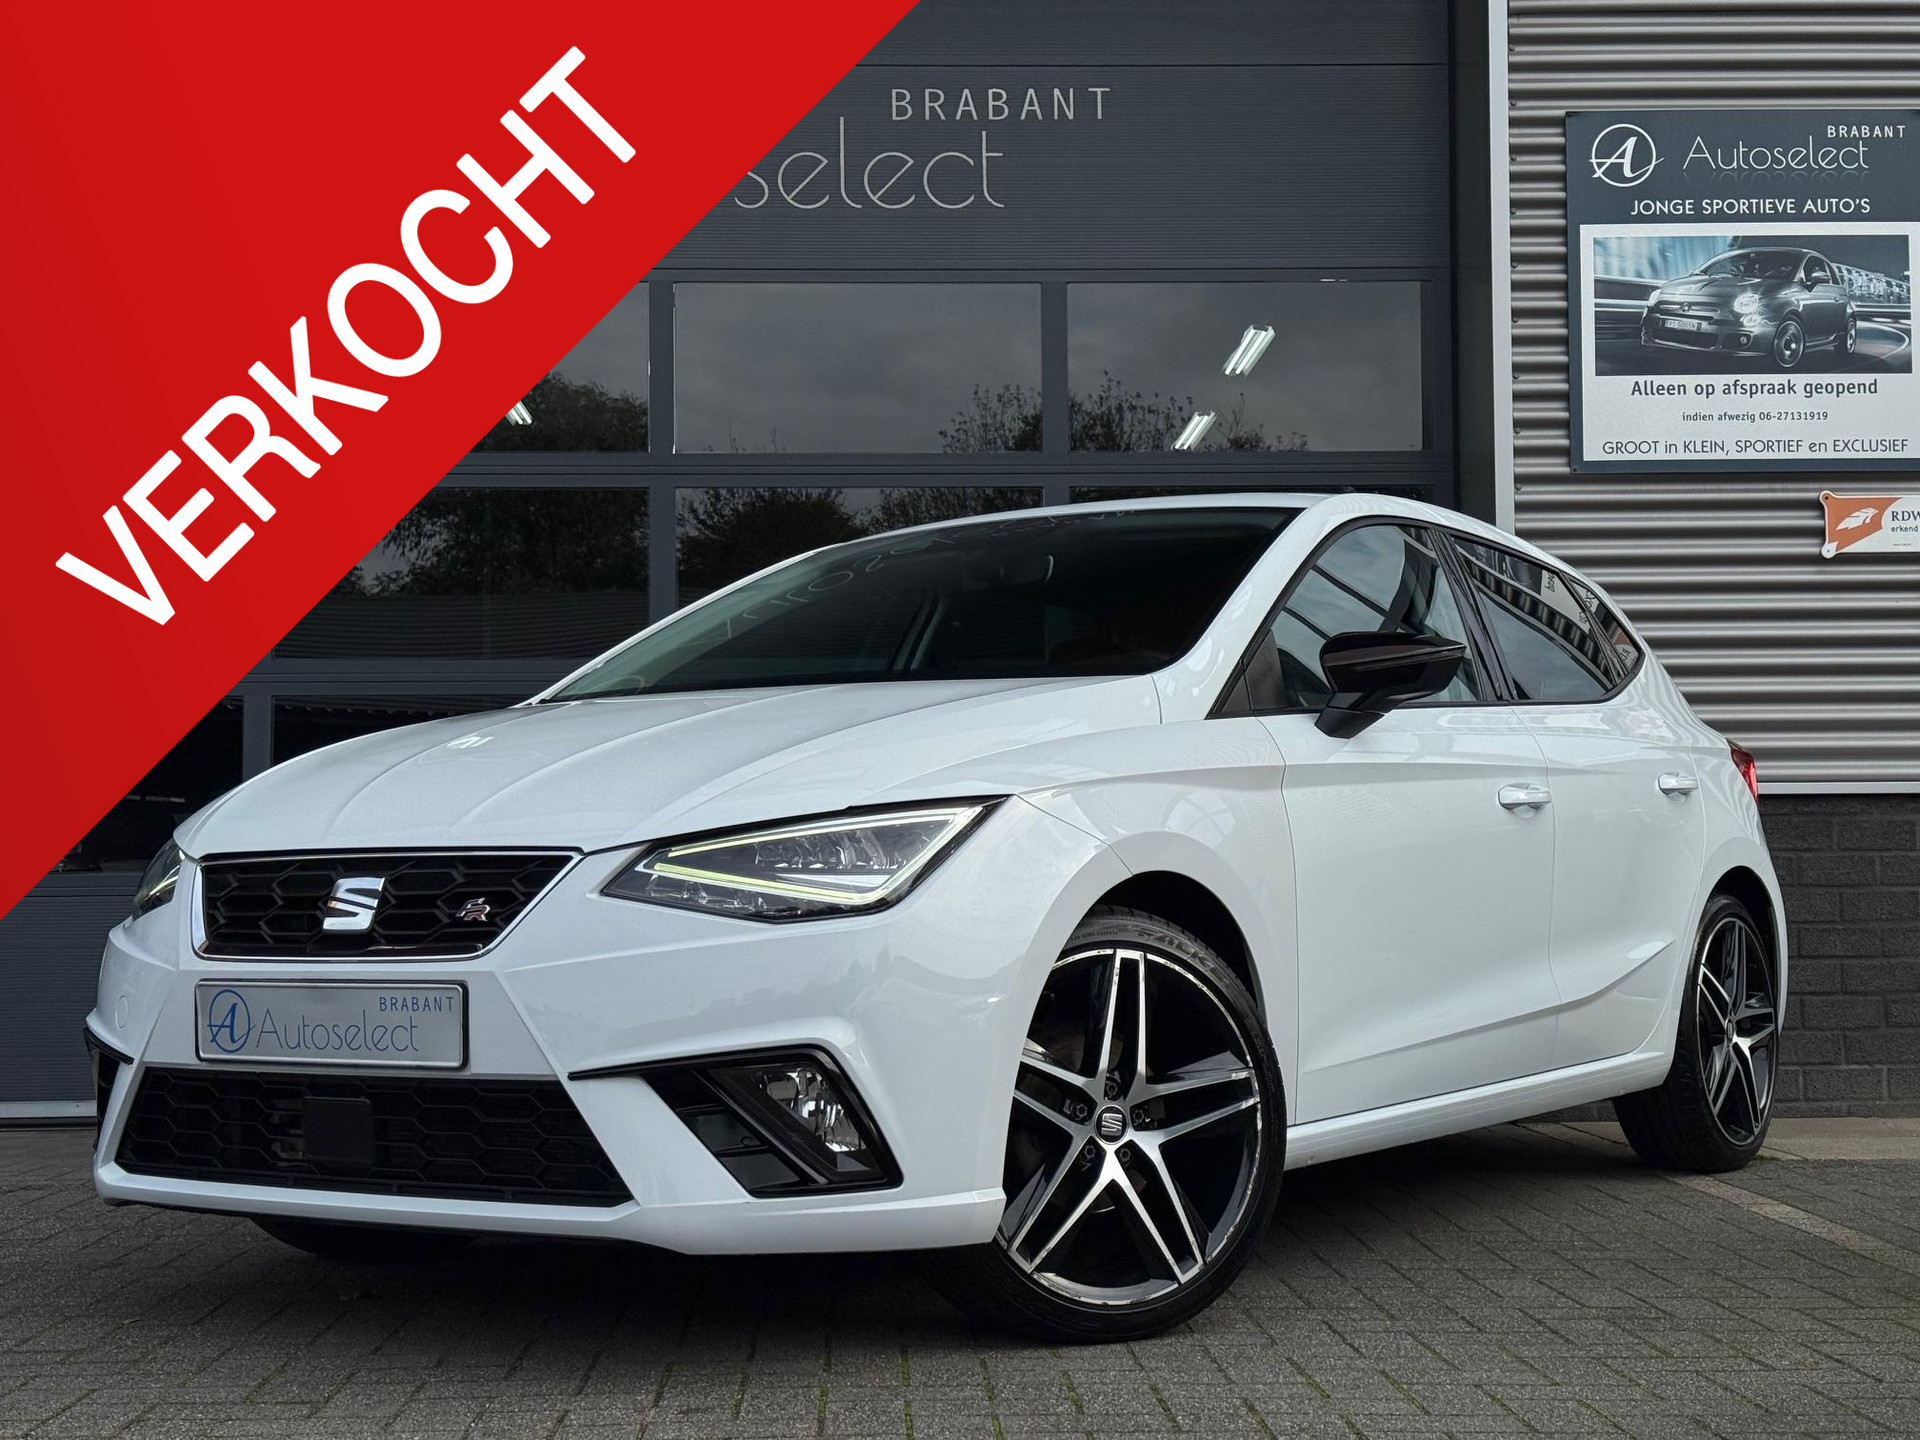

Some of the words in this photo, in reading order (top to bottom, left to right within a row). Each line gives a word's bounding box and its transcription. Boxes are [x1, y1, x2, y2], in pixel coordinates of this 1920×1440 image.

[891, 87, 1110, 120] BRABANT
[1827, 125, 1906, 138] BRABANT
[1683, 136, 1869, 169] Autoselect
[734, 116, 1005, 209] select
[1631, 200, 1695, 215] JONGE
[1702, 199, 1796, 214] SPORTIEVE
[1803, 198, 1871, 214] AUTO'S
[1631, 380, 1687, 396] Alleen
[1694, 383, 1716, 399] op
[1722, 379, 1797, 399] afspraak
[1803, 378, 1878, 398] geopend
[1682, 411, 1714, 421] indien
[1717, 411, 1756, 423] afwezig
[1758, 411, 1829, 421] 06-27131919
[1602, 440, 1660, 455] GROOT
[1664, 440, 1678, 454] in
[1683, 440, 1730, 456] KLEIN,
[1735, 439, 1804, 454] SPORTIEF
[1808, 442, 1828, 453] en
[1833, 438, 1909, 453] EXCLUSIEF
[1890, 524, 1919, 533] erkend
[379, 996, 455, 1012] BRABANT
[256, 1008, 419, 1052] Autoselect
